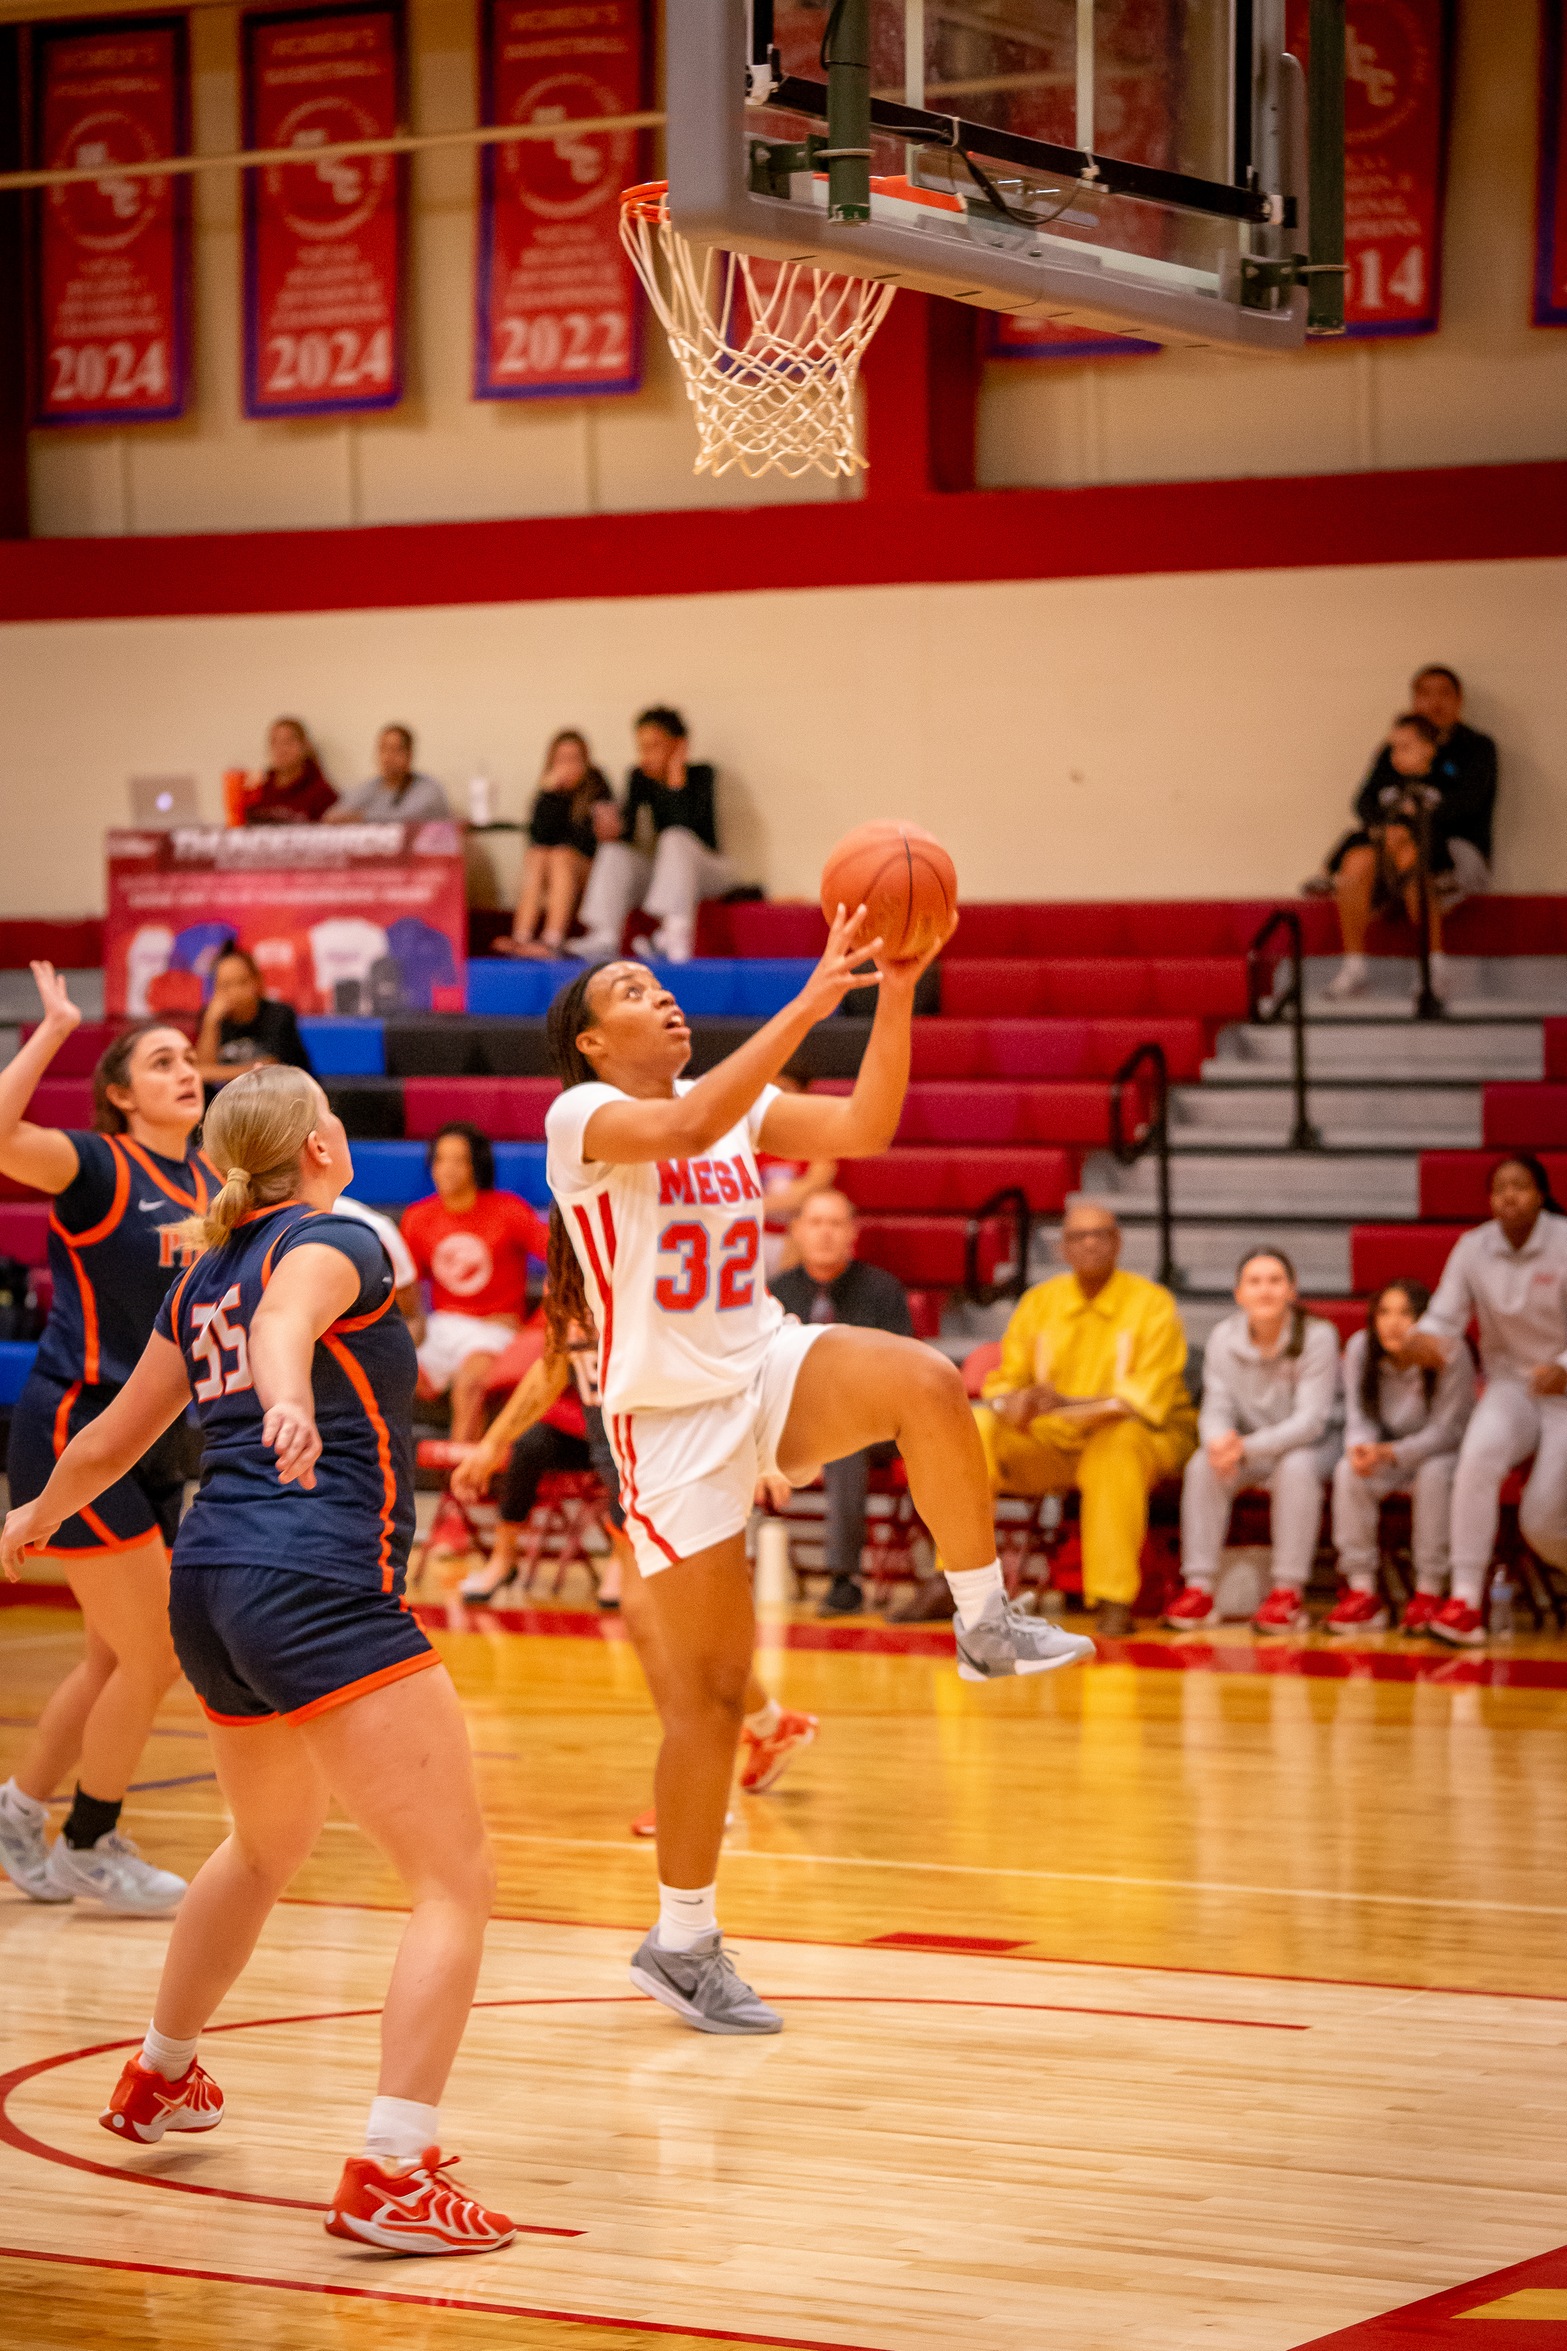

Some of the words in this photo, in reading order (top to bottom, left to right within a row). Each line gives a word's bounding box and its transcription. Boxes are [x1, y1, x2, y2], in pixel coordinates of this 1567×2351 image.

[1345, 247, 1422, 309] 14
[50, 339, 168, 400] 2024
[266, 327, 388, 391] 2024
[498, 312, 628, 372] 2022
[656, 1155, 762, 1206] MESA
[653, 1215, 760, 1313] 32
[191, 1283, 254, 1403] 35
